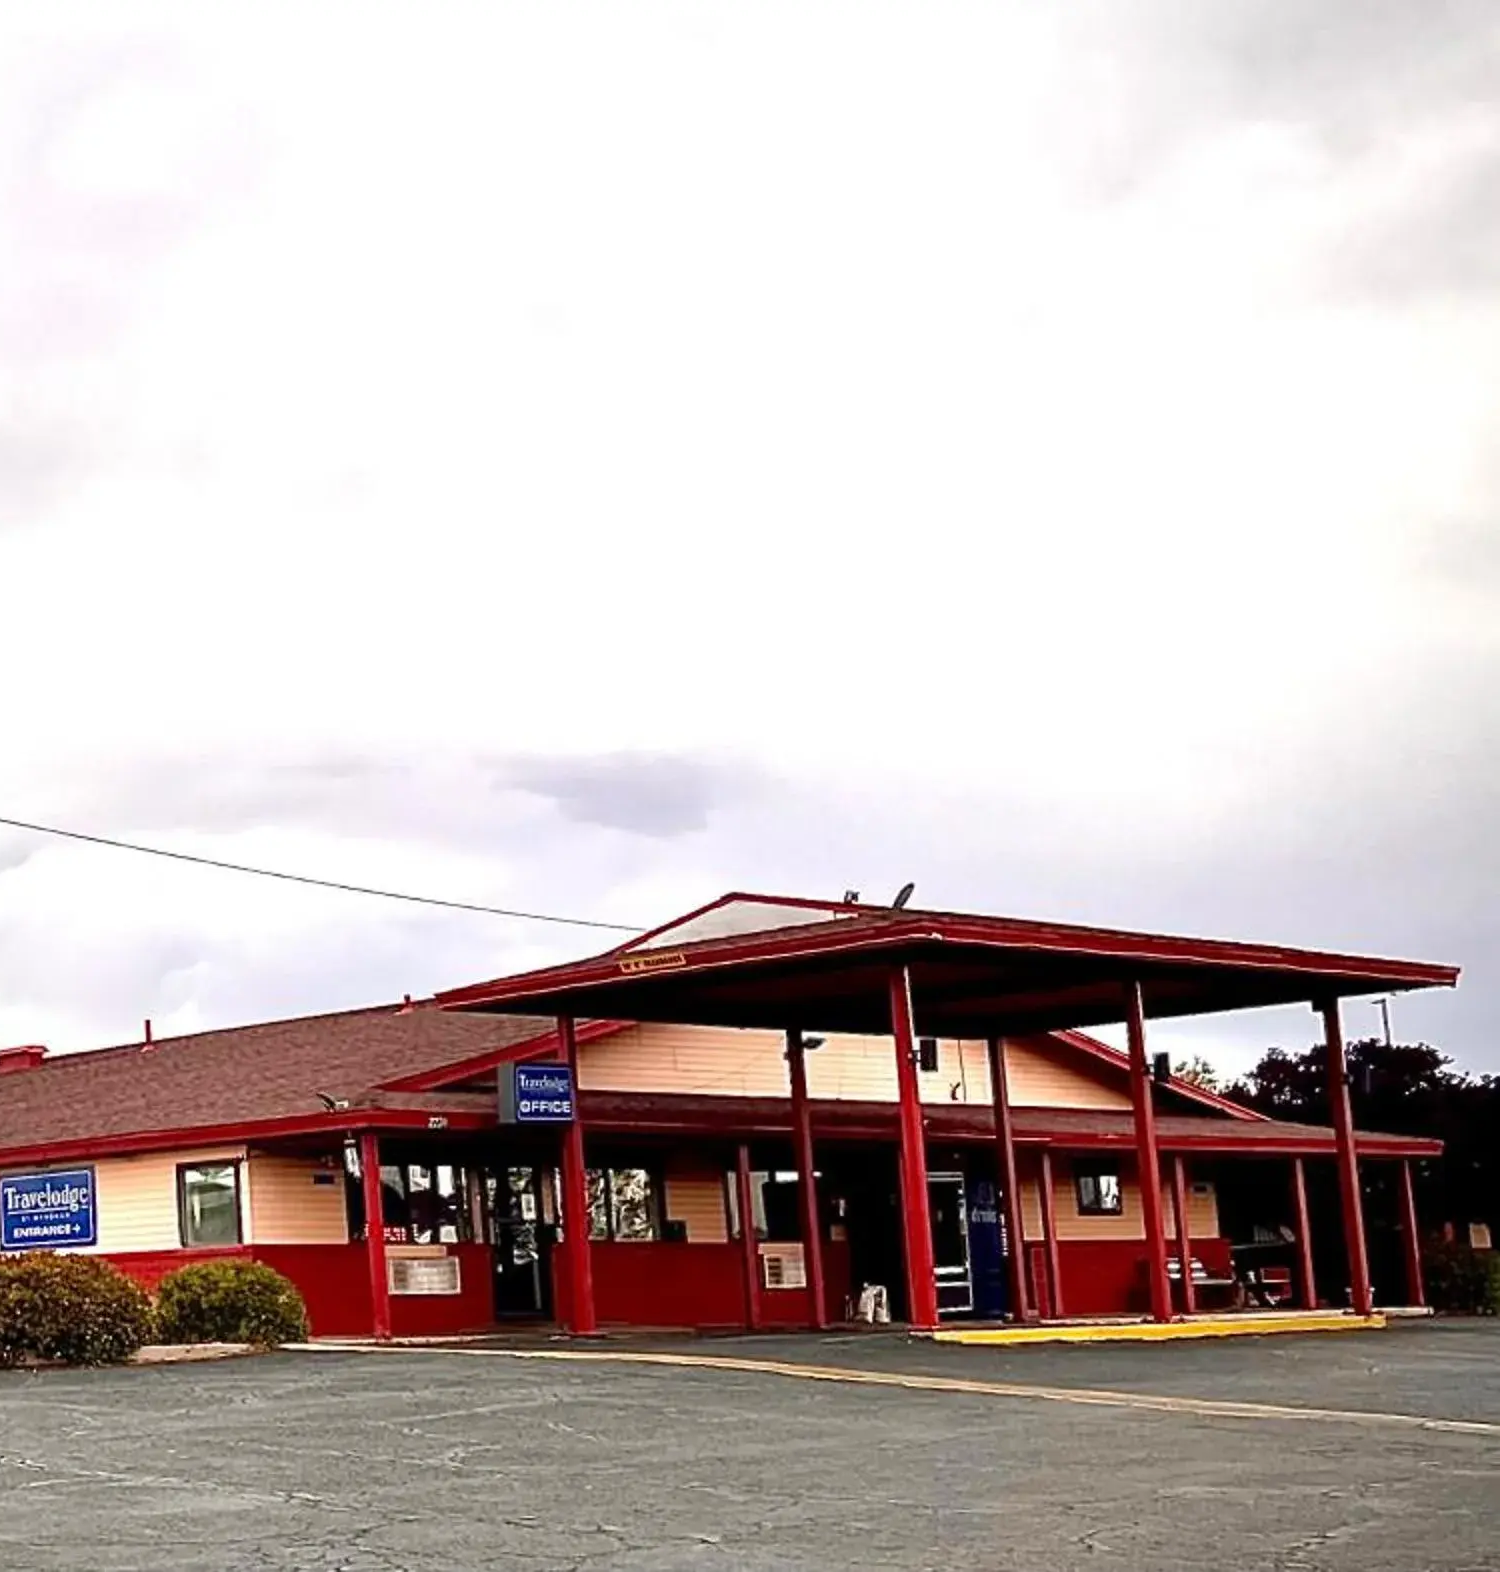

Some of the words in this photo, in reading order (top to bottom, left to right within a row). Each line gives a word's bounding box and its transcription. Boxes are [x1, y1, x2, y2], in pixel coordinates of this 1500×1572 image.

[520, 1100, 571, 1113] OFFICE
[3, 1183, 89, 1212] Travelodge
[13, 1223, 71, 1238] ENTRANCE
